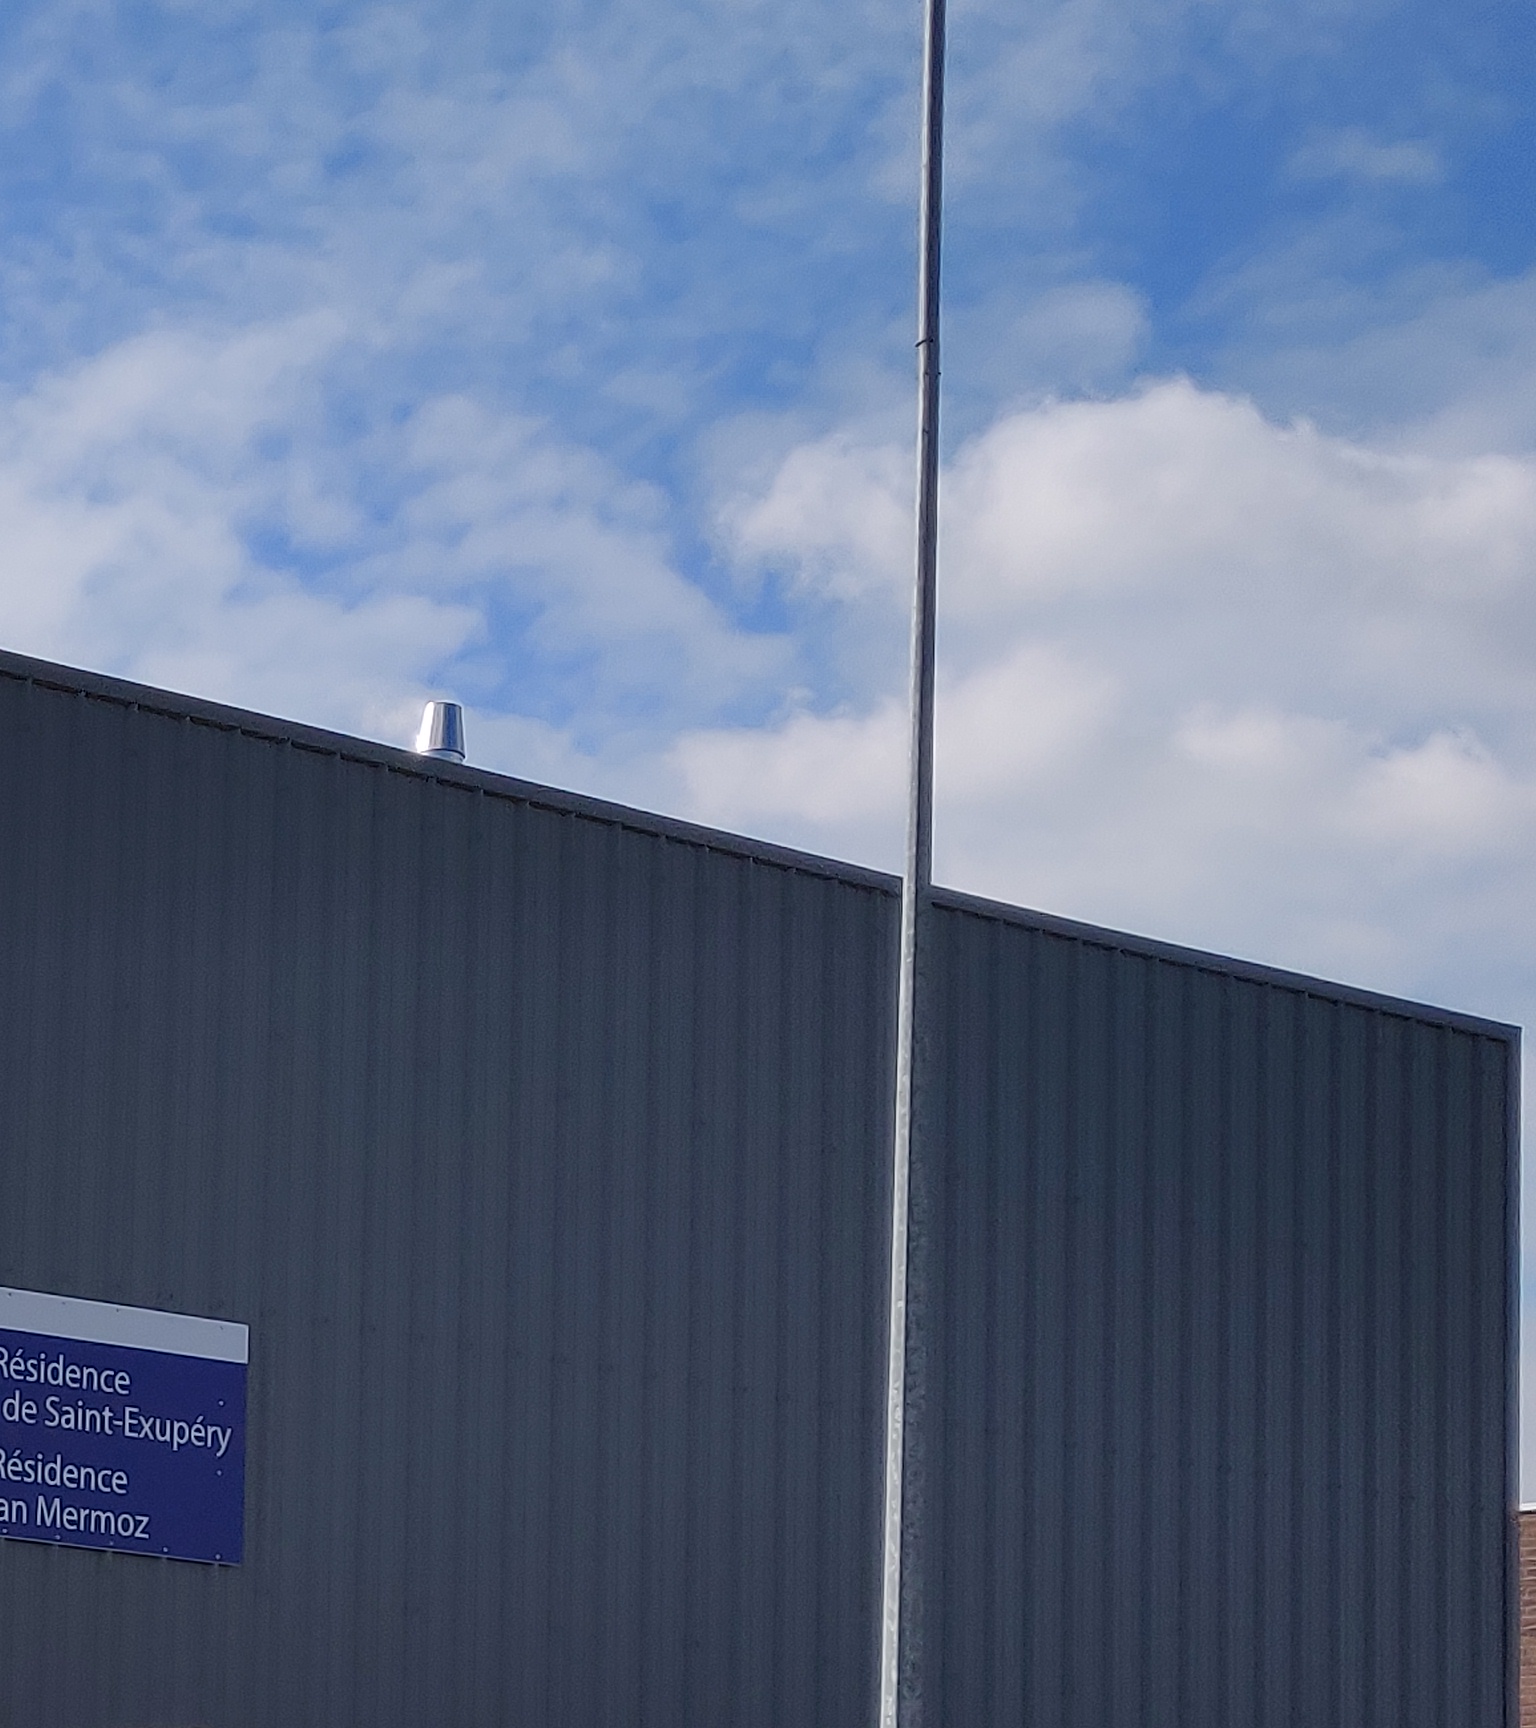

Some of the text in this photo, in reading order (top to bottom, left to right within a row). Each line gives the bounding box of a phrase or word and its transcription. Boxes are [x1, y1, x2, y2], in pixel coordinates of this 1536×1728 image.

[2, 1389, 37, 1424] de
[44, 1396, 232, 1457] Saint-Exupéry
[36, 1495, 150, 1539] Mermoz
